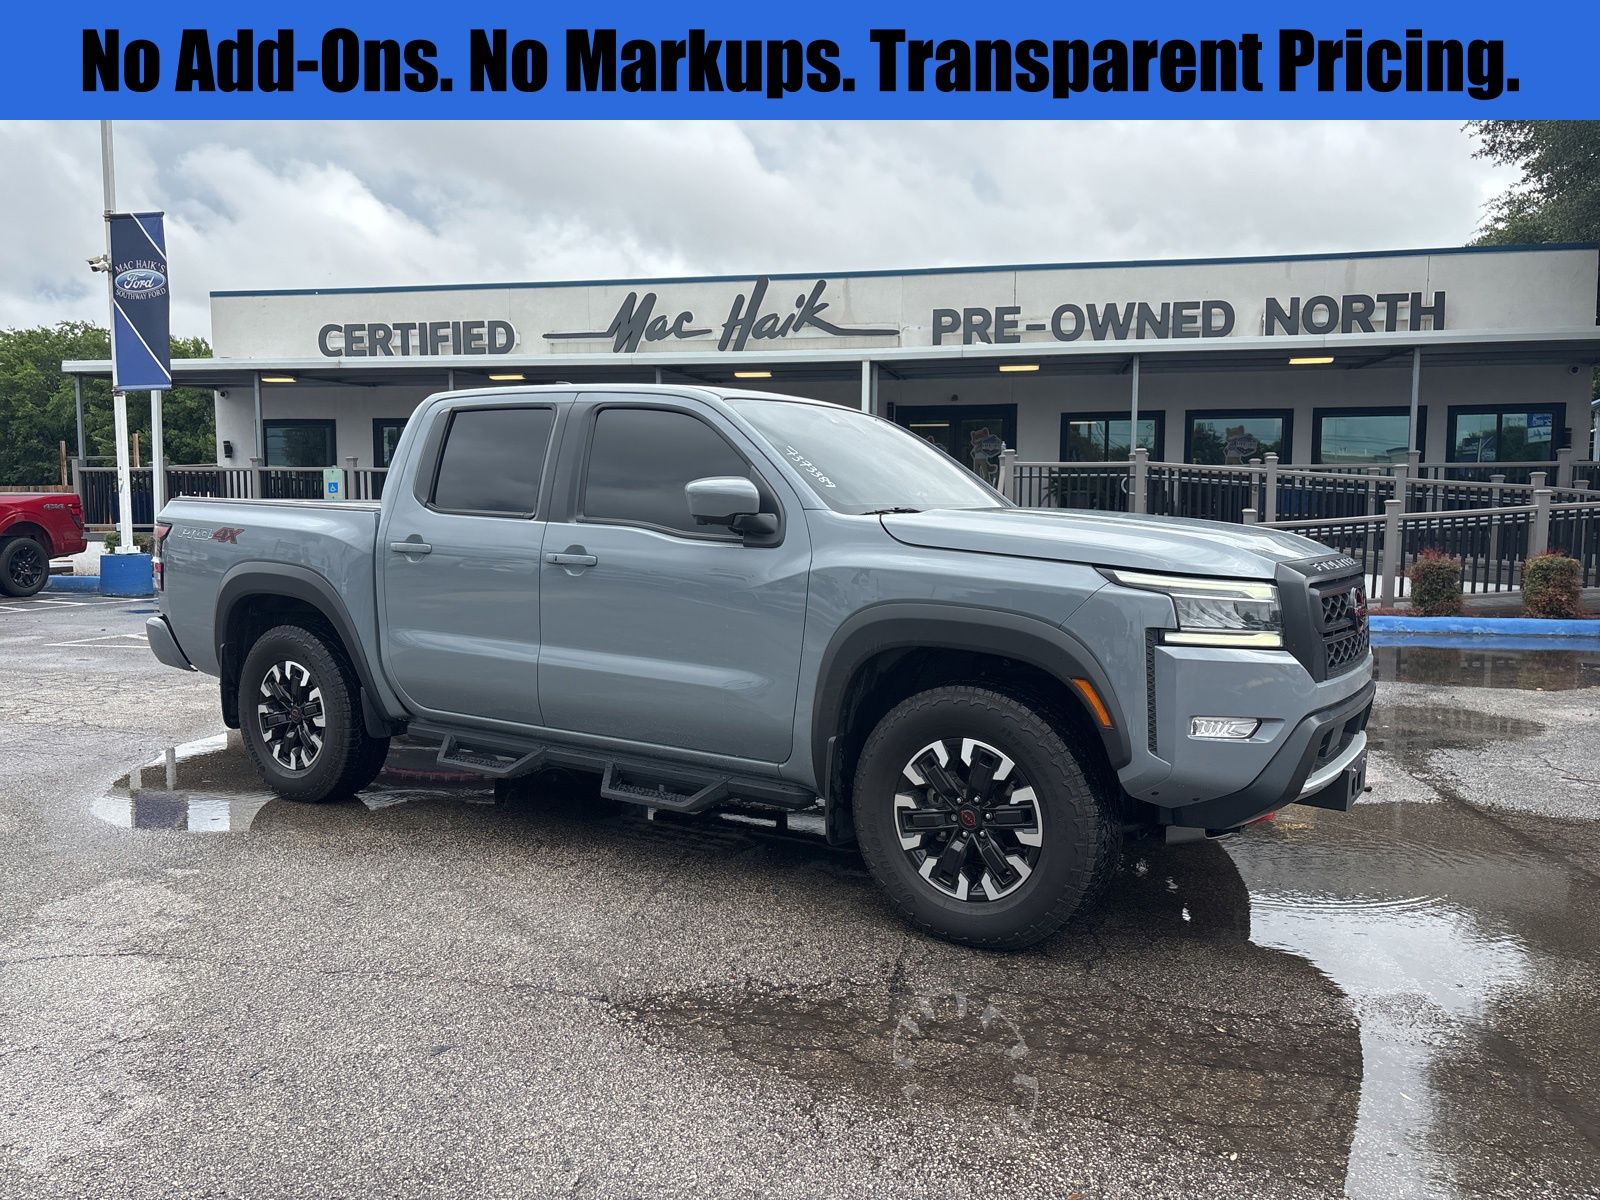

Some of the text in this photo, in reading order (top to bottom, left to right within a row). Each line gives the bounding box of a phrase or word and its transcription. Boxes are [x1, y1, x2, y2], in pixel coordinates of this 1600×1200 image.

[115, 260, 134, 274] MAC
[123, 272, 155, 289] Ford
[115, 287, 166, 300] SOUTHWAY FORD
[318, 275, 1446, 357] CERTIFIED Mac Haik PRE-OWNED NORTH
